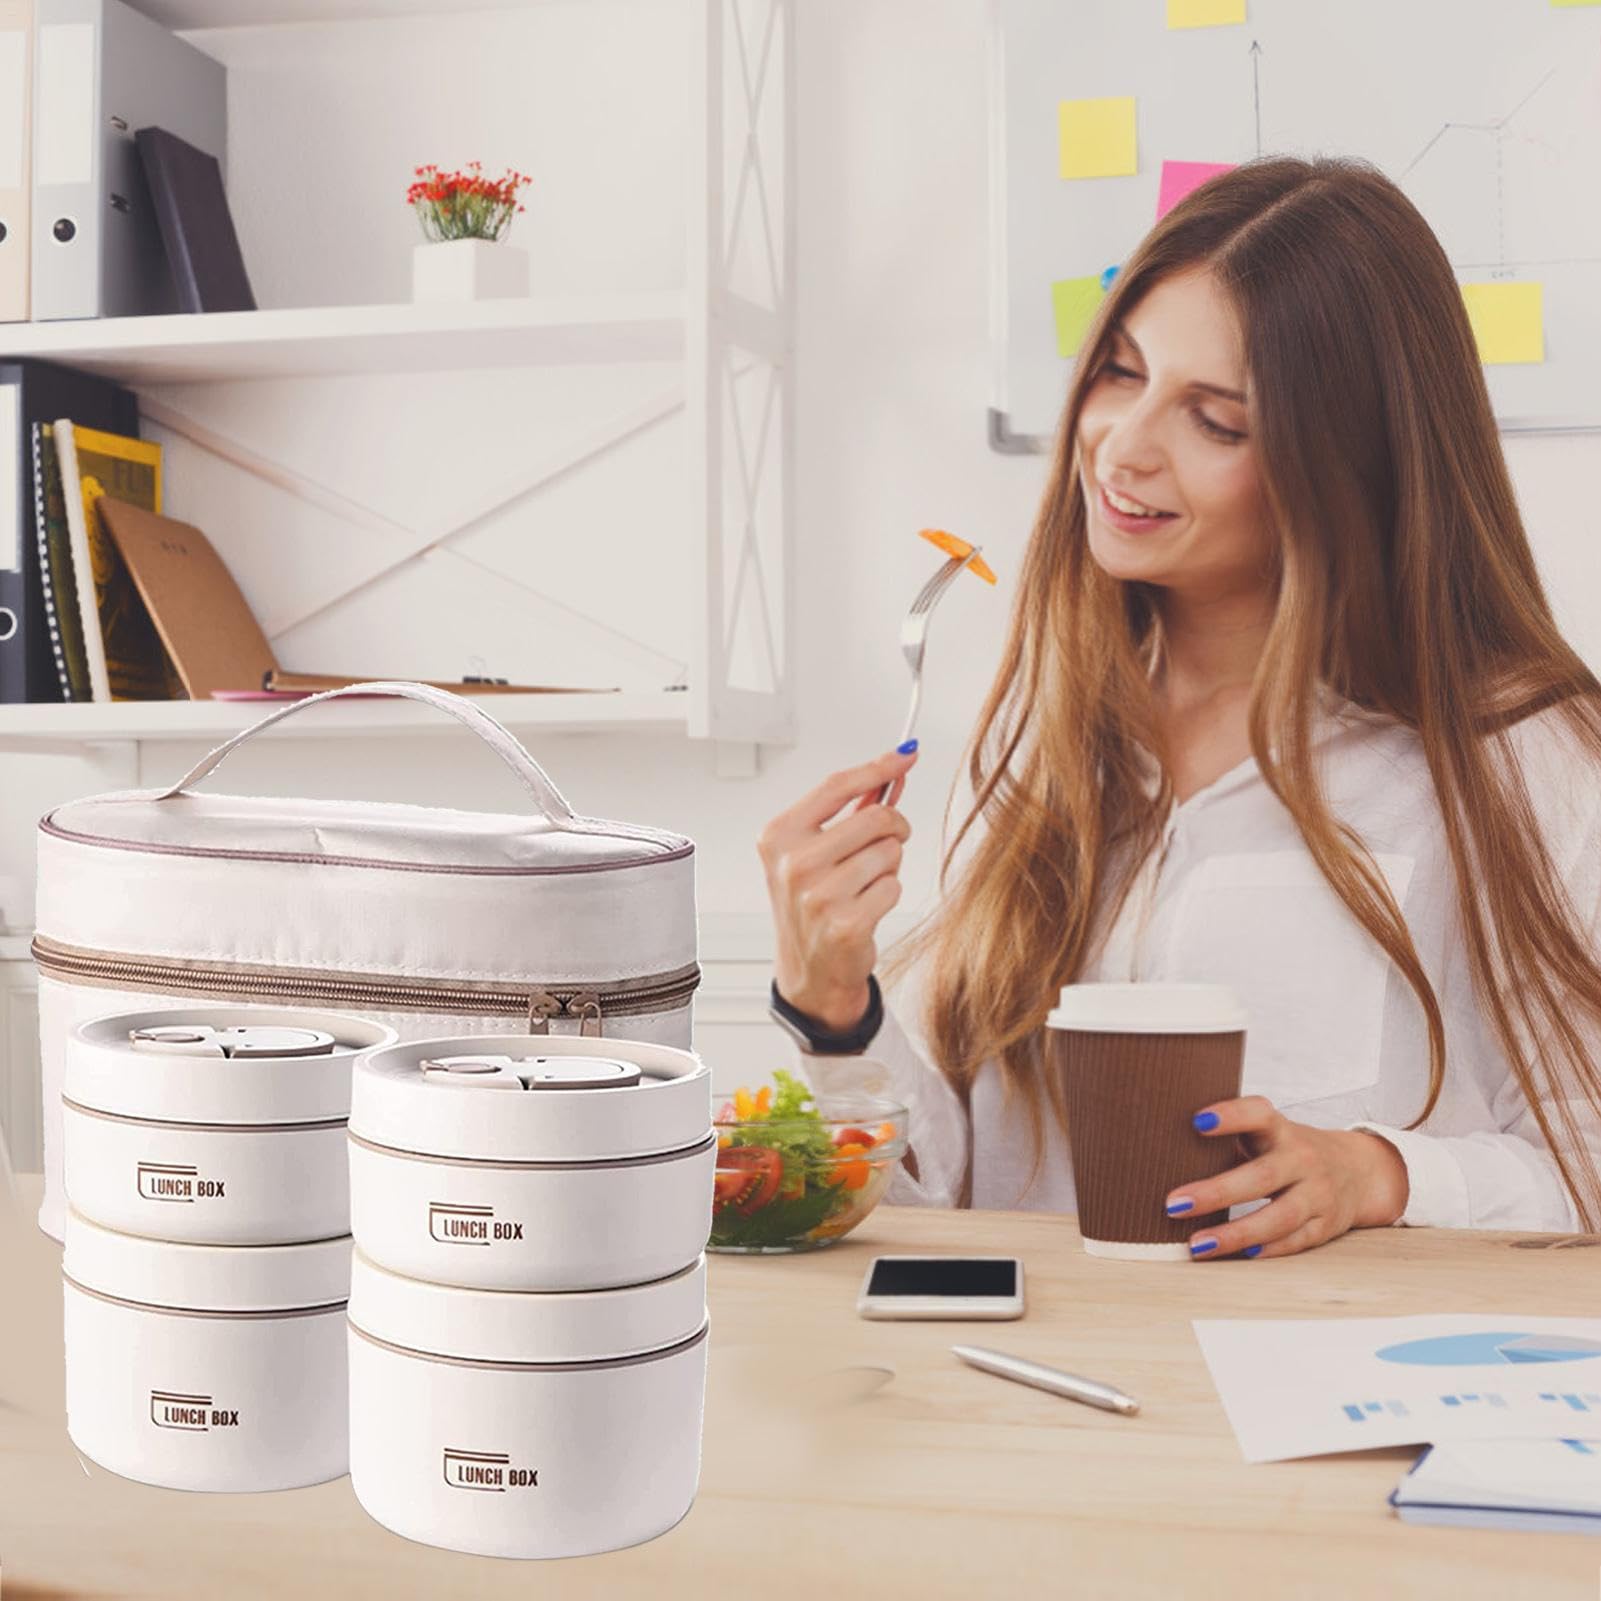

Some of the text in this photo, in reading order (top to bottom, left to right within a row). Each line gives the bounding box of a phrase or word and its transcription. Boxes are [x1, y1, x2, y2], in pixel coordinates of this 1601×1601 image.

[151, 1177, 225, 1198] LUNCH BOX
[444, 1219, 524, 1240] LUNCH BOX
[164, 1406, 239, 1426] LUNCH BOX
[458, 1465, 538, 1487] LUNCH BOX
